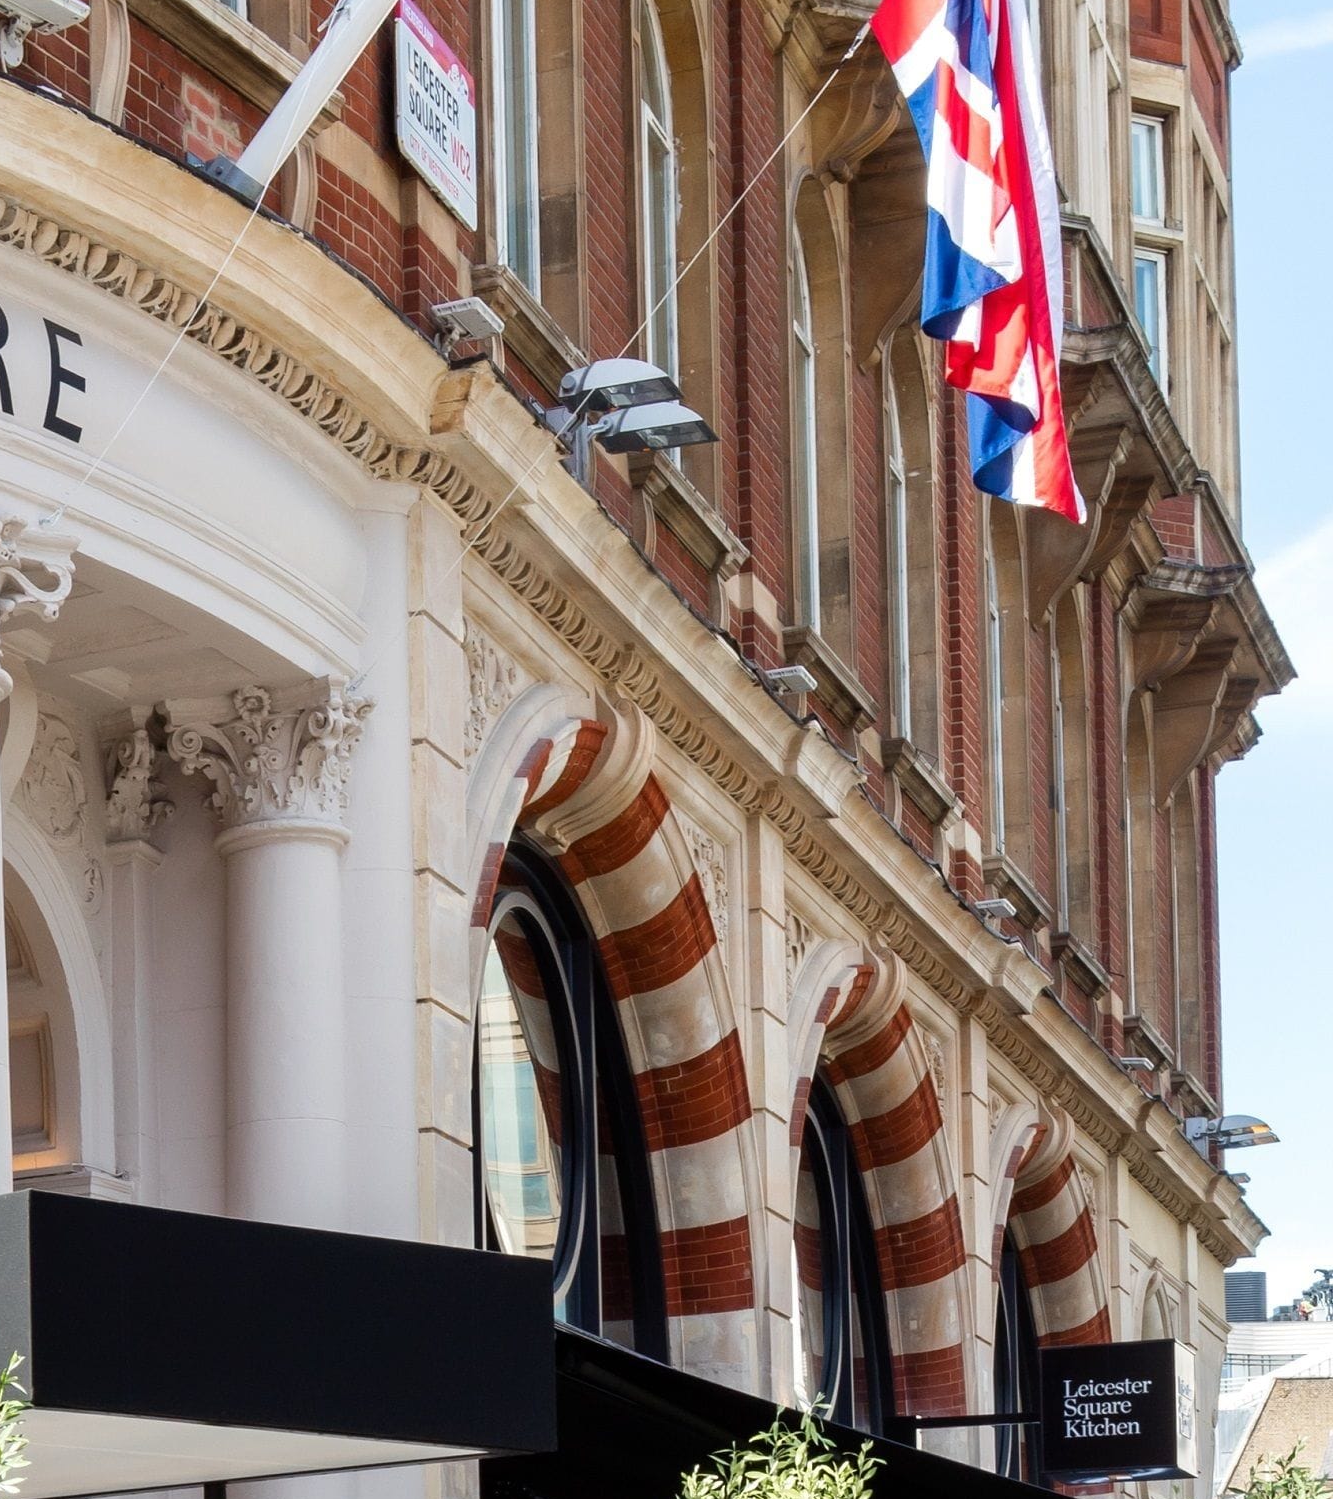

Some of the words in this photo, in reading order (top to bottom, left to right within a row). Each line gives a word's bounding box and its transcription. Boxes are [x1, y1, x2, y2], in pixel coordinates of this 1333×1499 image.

[407, 42, 460, 130] LEICESTER
[409, 83, 448, 155] SQUARE
[450, 132, 472, 181] WC2
[1062, 1378, 1152, 1398] Leicester
[1063, 1398, 1132, 1420] Square
[1064, 1417, 1141, 1438] Kitchen
